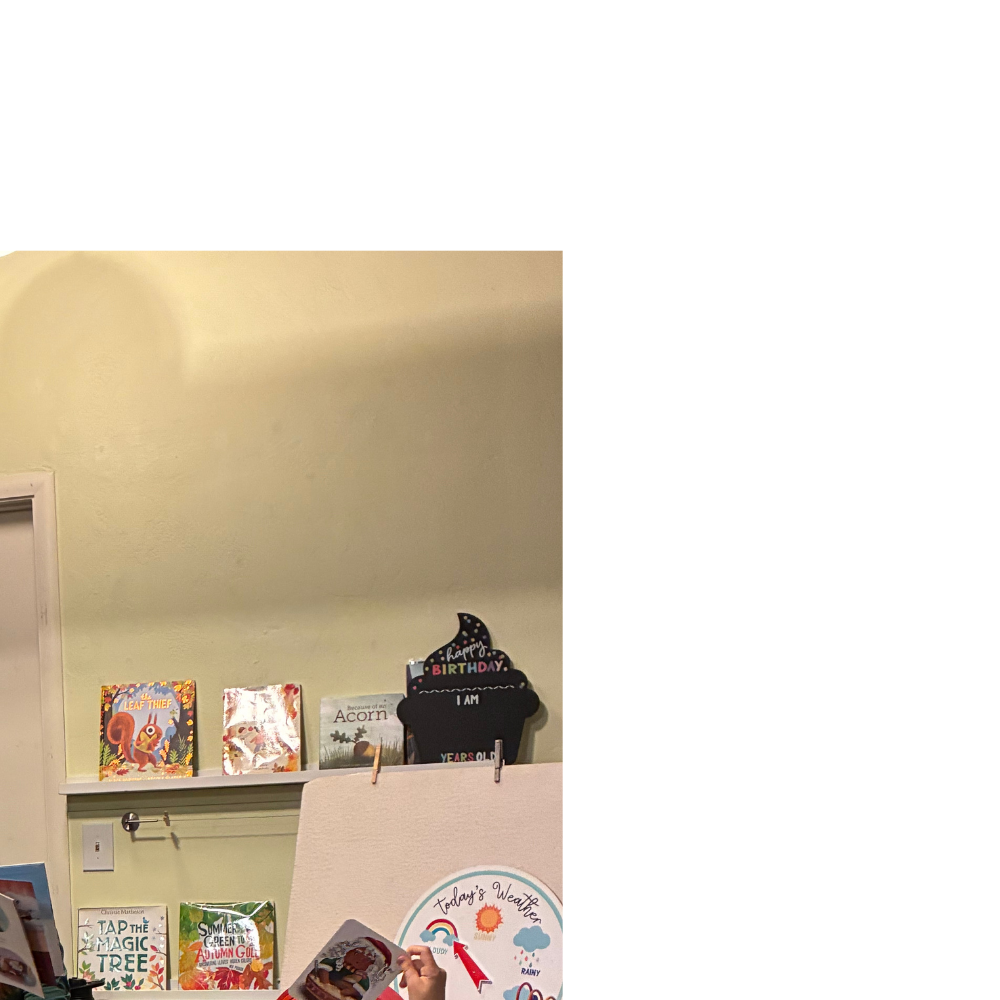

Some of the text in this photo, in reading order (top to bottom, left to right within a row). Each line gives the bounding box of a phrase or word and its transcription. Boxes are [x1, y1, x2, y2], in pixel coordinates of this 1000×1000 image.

[446, 640, 488, 662] happy
[432, 660, 504, 676] BIRTHDAY
[123, 698, 172, 711] LEAF THIEF
[456, 694, 479, 706] I AM
[333, 709, 388, 723] Acorn
[440, 751, 497, 763] YEARS OLD
[493, 881, 542, 925] Weather
[97, 919, 149, 935] TAP THE
[96, 936, 149, 952] MAGIC
[473, 932, 497, 943] SUNNY
[195, 947, 234, 962] AUTUMN
[96, 953, 148, 973] TREE
[521, 967, 541, 977] RAINY
